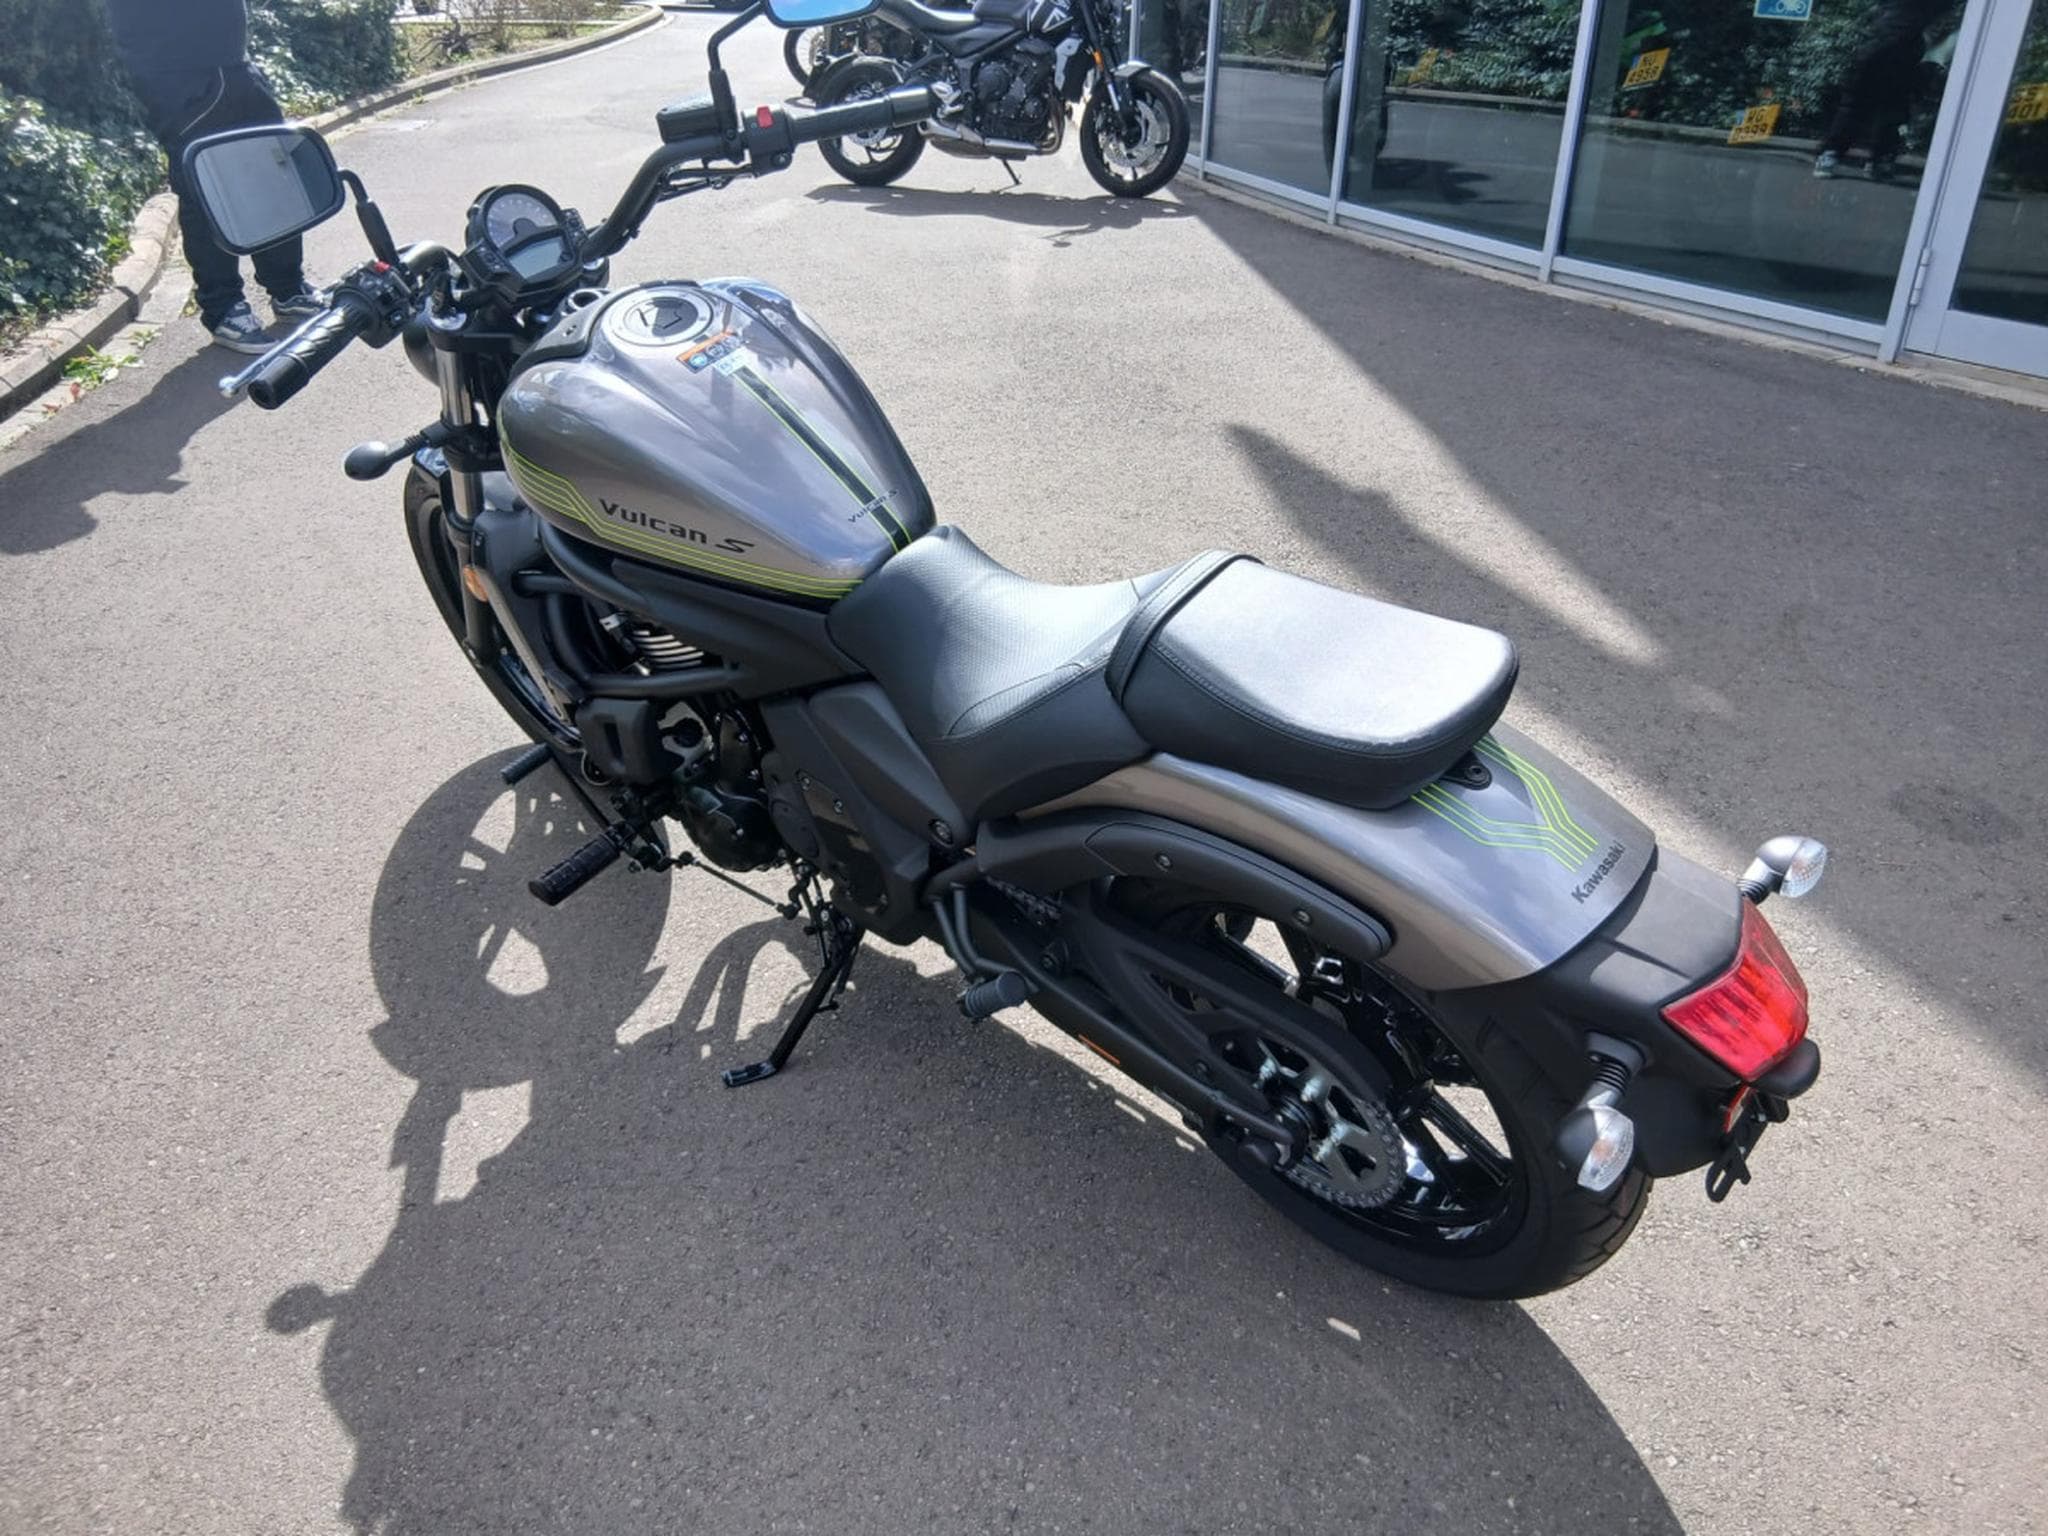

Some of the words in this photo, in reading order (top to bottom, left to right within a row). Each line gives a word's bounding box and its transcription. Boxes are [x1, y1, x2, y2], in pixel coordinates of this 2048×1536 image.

[598, 498, 708, 544] Vulcan
[715, 538, 755, 553] S
[848, 495, 887, 523] Vulcan
[1570, 839, 1627, 904] Kawasaki
